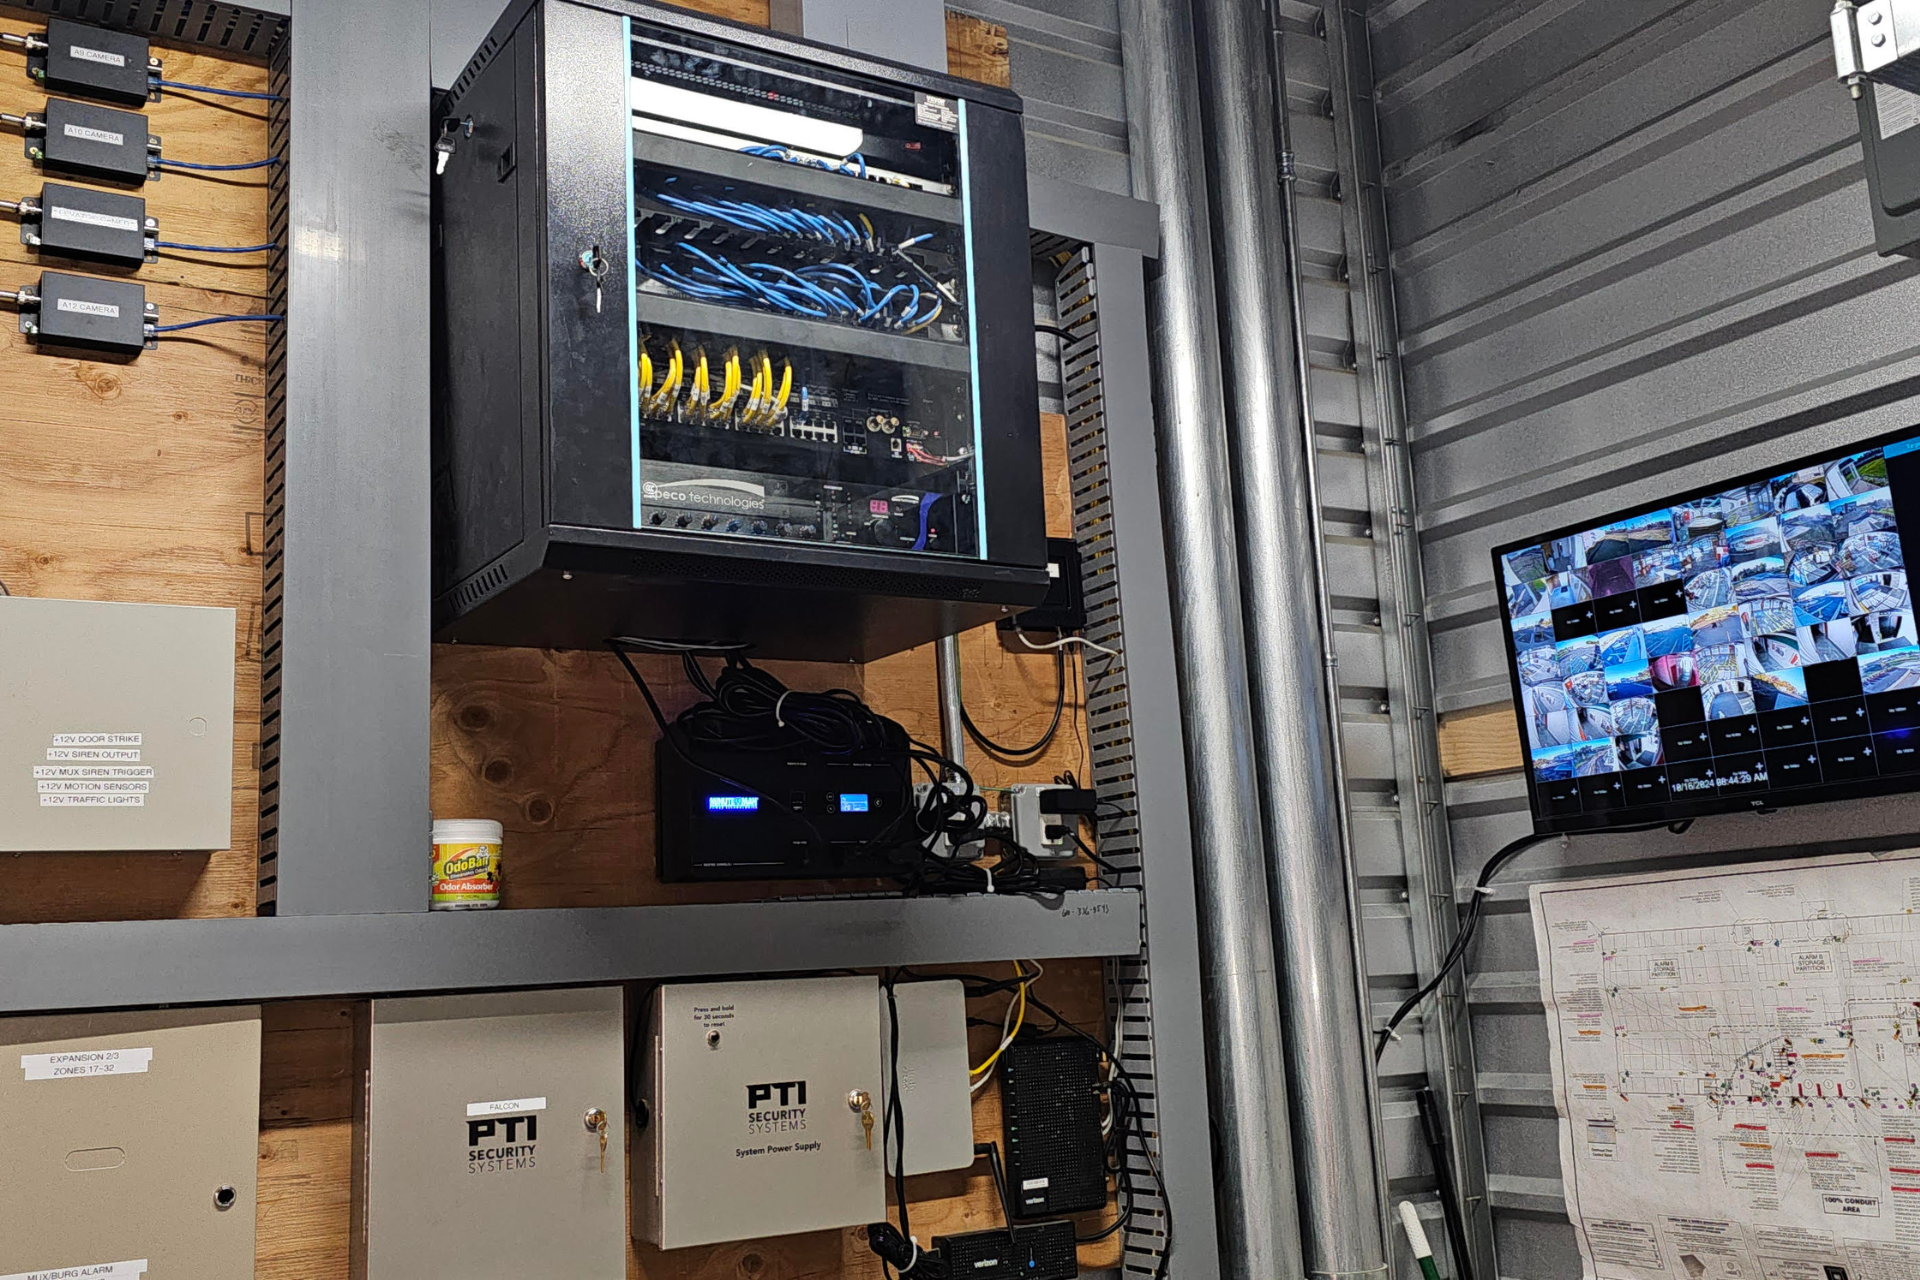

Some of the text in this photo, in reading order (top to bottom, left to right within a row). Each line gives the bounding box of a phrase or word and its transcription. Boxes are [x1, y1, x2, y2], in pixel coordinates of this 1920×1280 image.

[74, 49, 121, 63] A9 CAMERA
[68, 127, 120, 142] A10 CAMERA
[79, 304, 116, 314] CAMERA
[688, 491, 765, 510] technologies
[54, 735, 140, 743] +12V DOOR STRIKE
[48, 750, 69, 758] +12V
[101, 751, 138, 759] OUTPUT
[35, 768, 153, 776] +12V MUX SIREN TRIGGER
[64, 782, 101, 790] MOTION
[103, 783, 148, 791] SENSORS
[1671, 771, 1768, 792] 10/16/2024 08:44:29 AM
[42, 796, 140, 804] +12V TRAFFIC LIGHTS
[440, 882, 494, 891] Odor Absorber
[50, 1052, 119, 1064] EXPANSION 2/3
[53, 1064, 115, 1076] ZONES 17-32
[745, 1080, 807, 1109] PTI
[489, 1102, 520, 1110] FALCON
[748, 1108, 806, 1123] SECURITY
[466, 1115, 537, 1146] PTI
[748, 1119, 807, 1135] SYSTEMS
[468, 1144, 536, 1161] SECURITY
[736, 1140, 821, 1158] System Power Supply
[468, 1156, 536, 1174] SYSTEMS
[1025, 1197, 1045, 1205] verizon
[1844, 1198, 1877, 1206] CONDUIT
[974, 1259, 998, 1268] verizon
[27, 1266, 114, 1280] MUX/BURG ALARM
